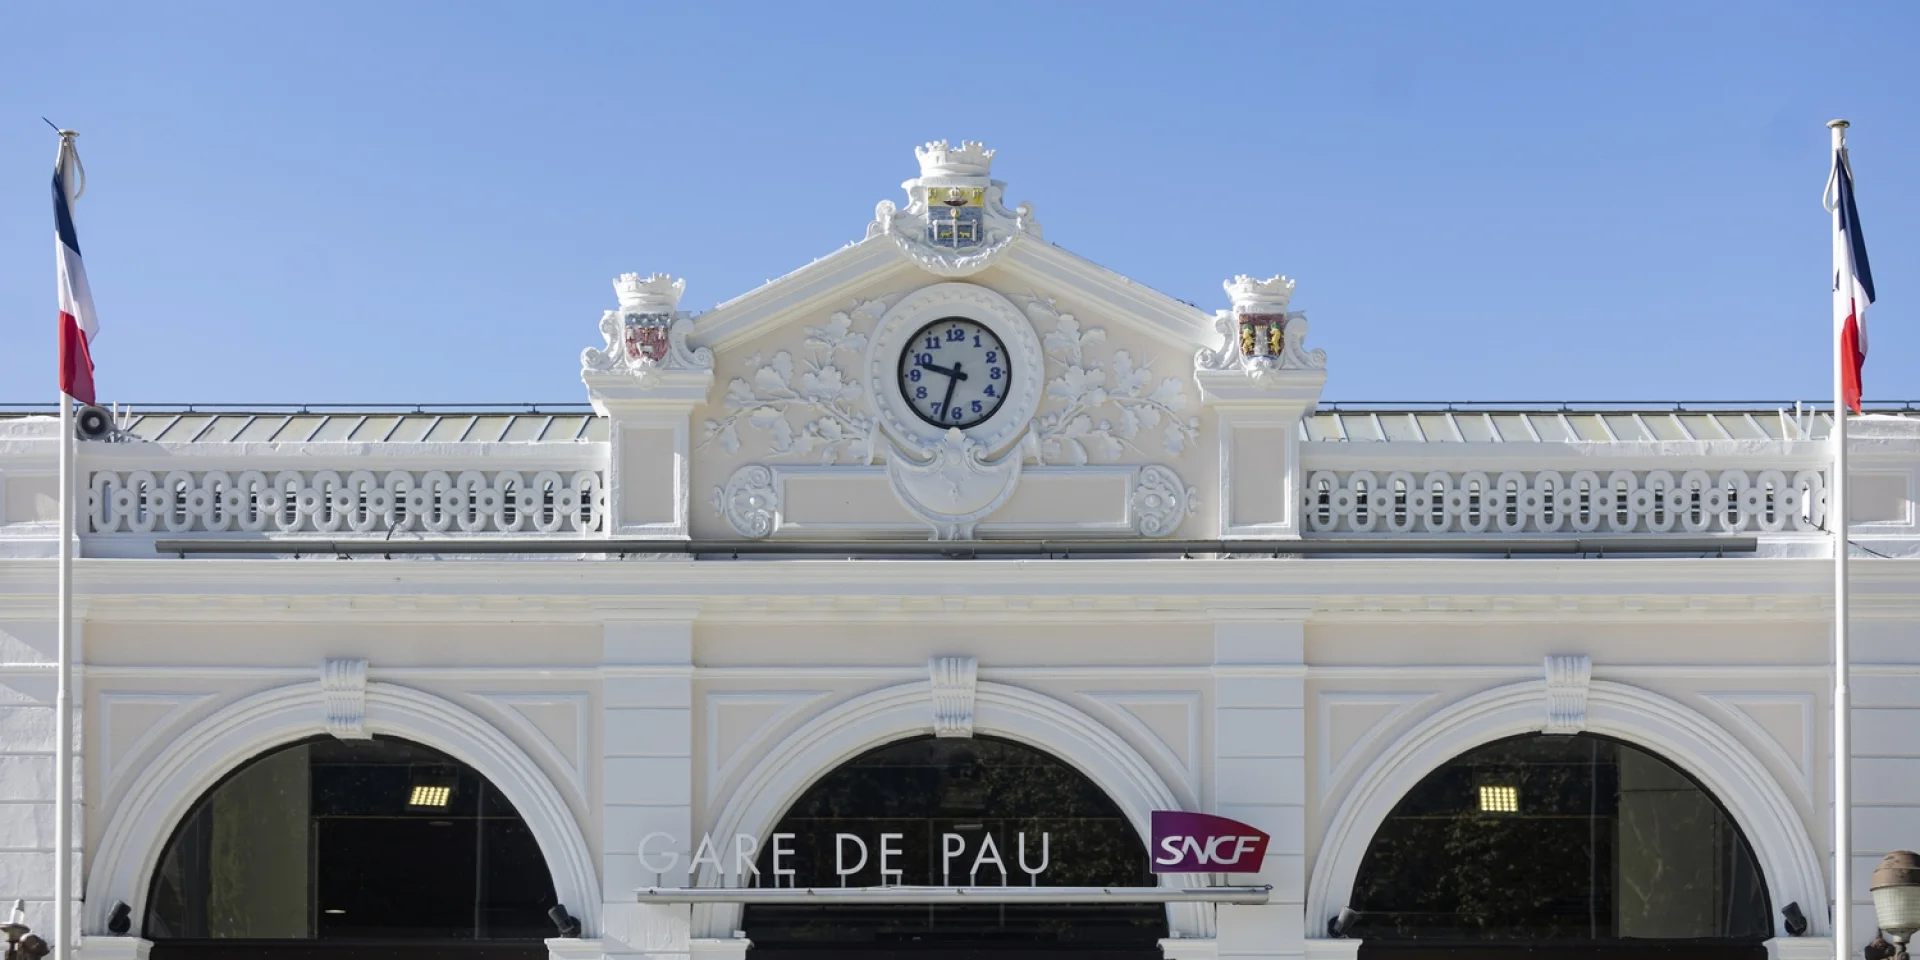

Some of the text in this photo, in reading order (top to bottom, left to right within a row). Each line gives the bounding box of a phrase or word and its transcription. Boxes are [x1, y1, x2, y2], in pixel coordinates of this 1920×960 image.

[946, 329, 965, 342] 12
[973, 335, 982, 347] 1
[925, 336, 941, 349] 11
[914, 353, 933, 366] 10
[986, 351, 997, 363] 2
[910, 369, 921, 381] 9
[990, 367, 1001, 379] 3
[916, 386, 927, 399] 8
[983, 384, 995, 397] 4
[930, 402, 942, 414] 7
[971, 400, 982, 412] 5
[951, 407, 962, 419] 6
[638, 832, 1049, 875] GARE DE PAU
[1156, 835, 1261, 865] SNCF
